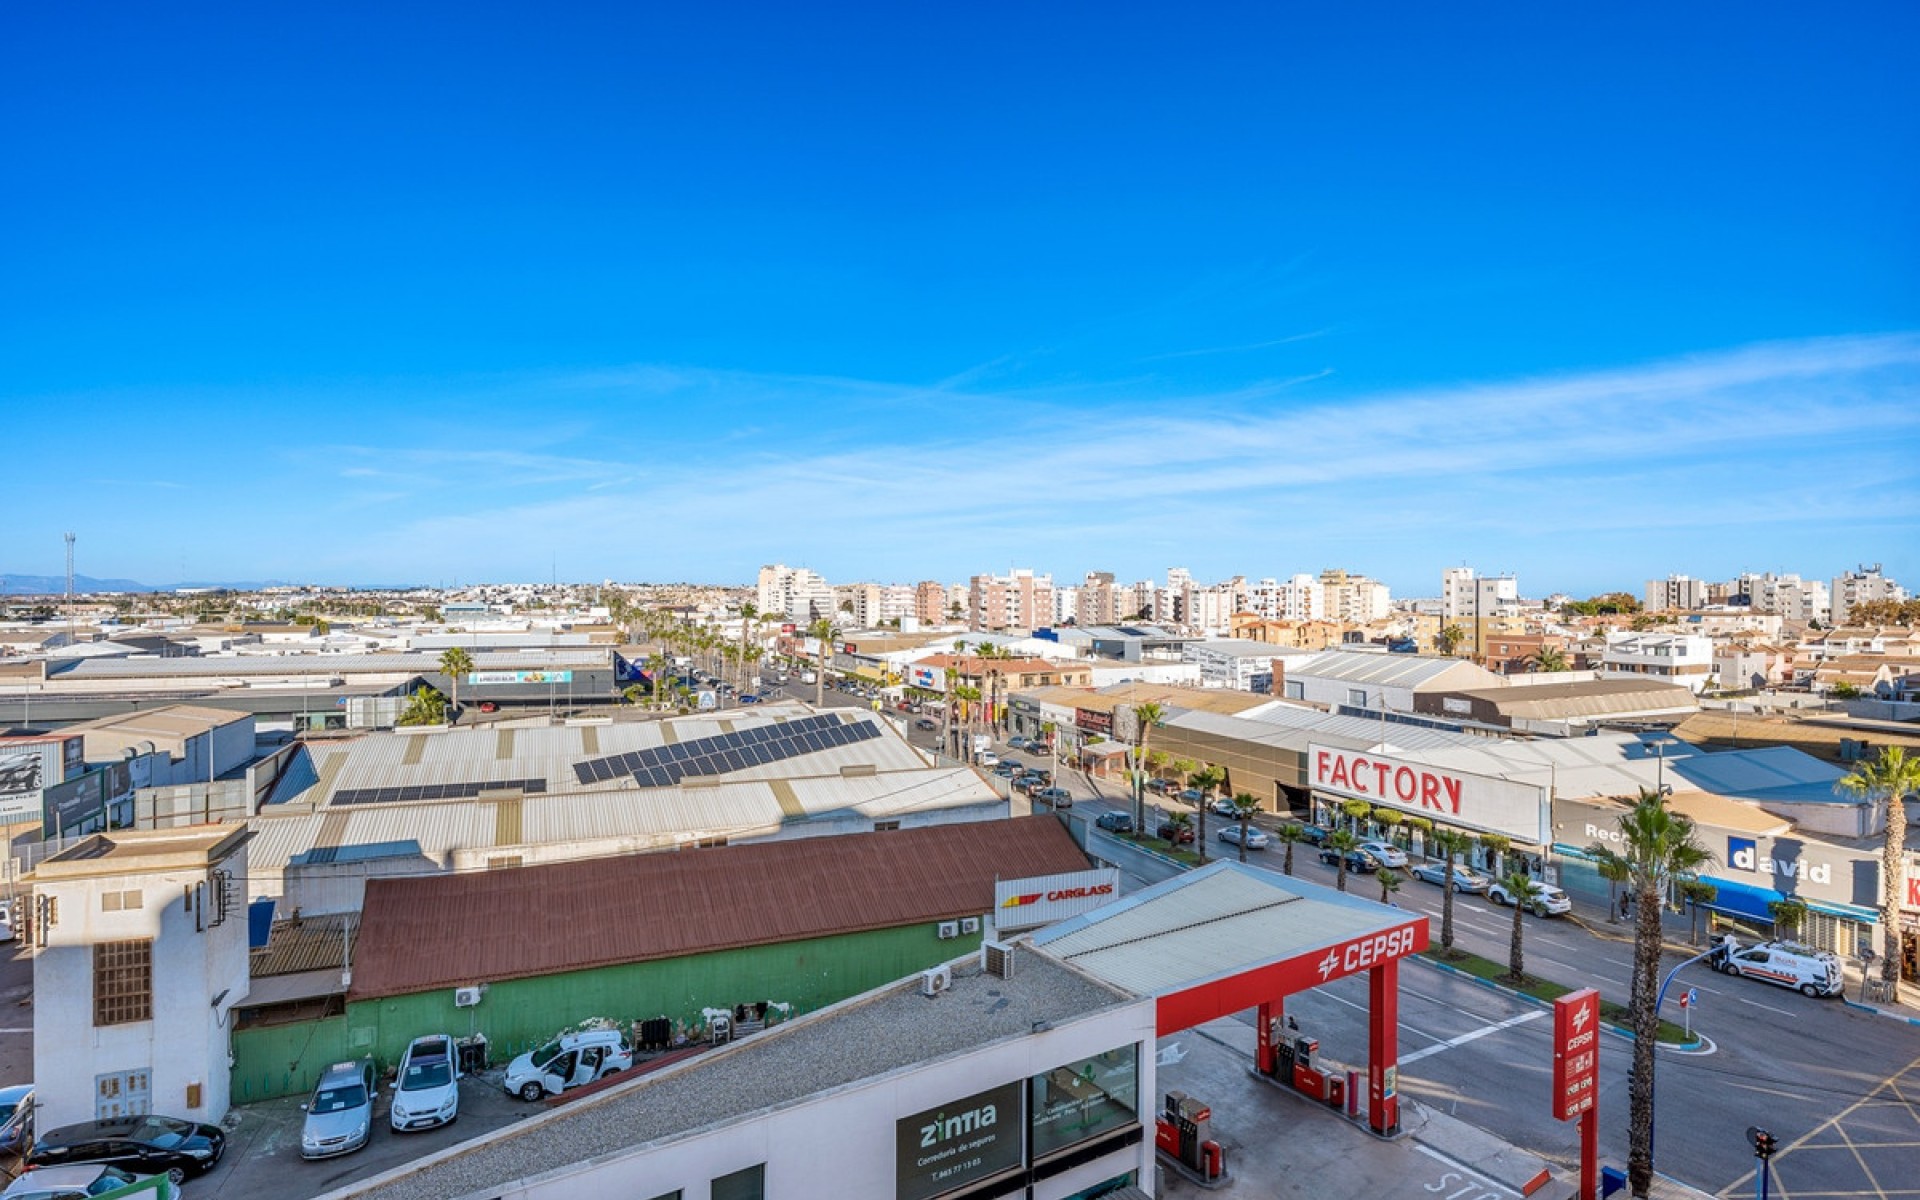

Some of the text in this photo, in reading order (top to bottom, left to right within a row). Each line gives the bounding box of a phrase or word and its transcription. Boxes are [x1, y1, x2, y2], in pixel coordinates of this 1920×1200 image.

[1317, 751, 1463, 814] FACTORY
[1733, 847, 1832, 885] david
[1047, 884, 1112, 901] CARGLASS
[1343, 926, 1415, 972] CEPSA
[1567, 1030, 1593, 1052] CEPSA
